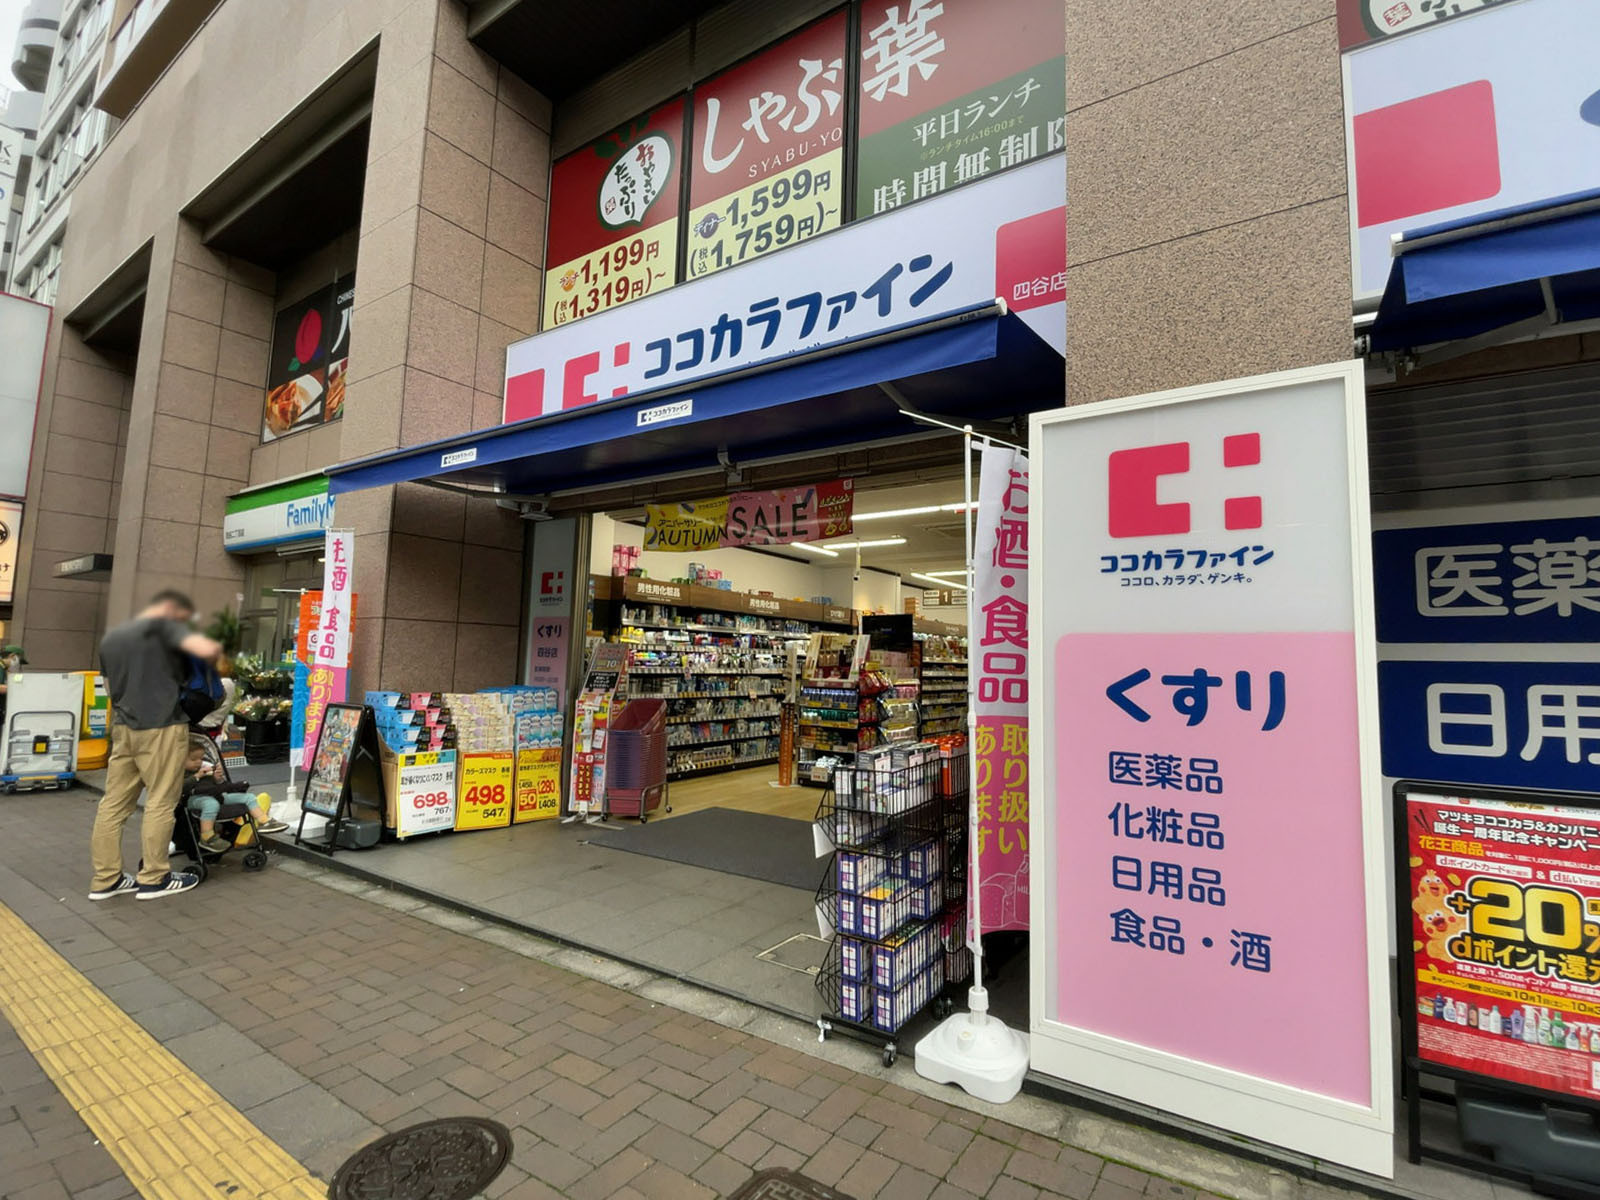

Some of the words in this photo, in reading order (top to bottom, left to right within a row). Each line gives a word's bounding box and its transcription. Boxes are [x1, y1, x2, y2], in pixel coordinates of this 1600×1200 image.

[912, 78, 1041, 147] 平日ランチ
[748, 127, 843, 178] SYABU-YO
[726, 168, 831, 229] 1,599円
[580, 238, 660, 286] 1,199円
[1013, 272, 1066, 301] 四谷店
[643, 253, 954, 380] ココカラファイン
[657, 522, 729, 546] AUTUMN
[732, 502, 809, 540] SALE
[1100, 545, 1275, 573] ココカラファイン
[1120, 572, 1253, 587] ココロ、カラダ、ゲンキ。
[1415, 536, 1600, 617] 医薬
[537, 624, 562, 638] くすり
[1106, 667, 1286, 732] くすり
[1427, 682, 1600, 764] 日用
[465, 784, 505, 805] 498
[998, 723, 1029, 855] 取り扱い
[1109, 751, 1223, 795] 医薬品
[413, 791, 448, 809] 698
[483, 808, 505, 818] 547
[1108, 802, 1225, 850] 化粧品
[1418, 835, 1485, 857] 花王商品
[1437, 810, 1600, 838] マツキヨココカラ&カンパニ
[1112, 855, 1226, 907] 日用品
[1110, 908, 1272, 974] 食品・酒
